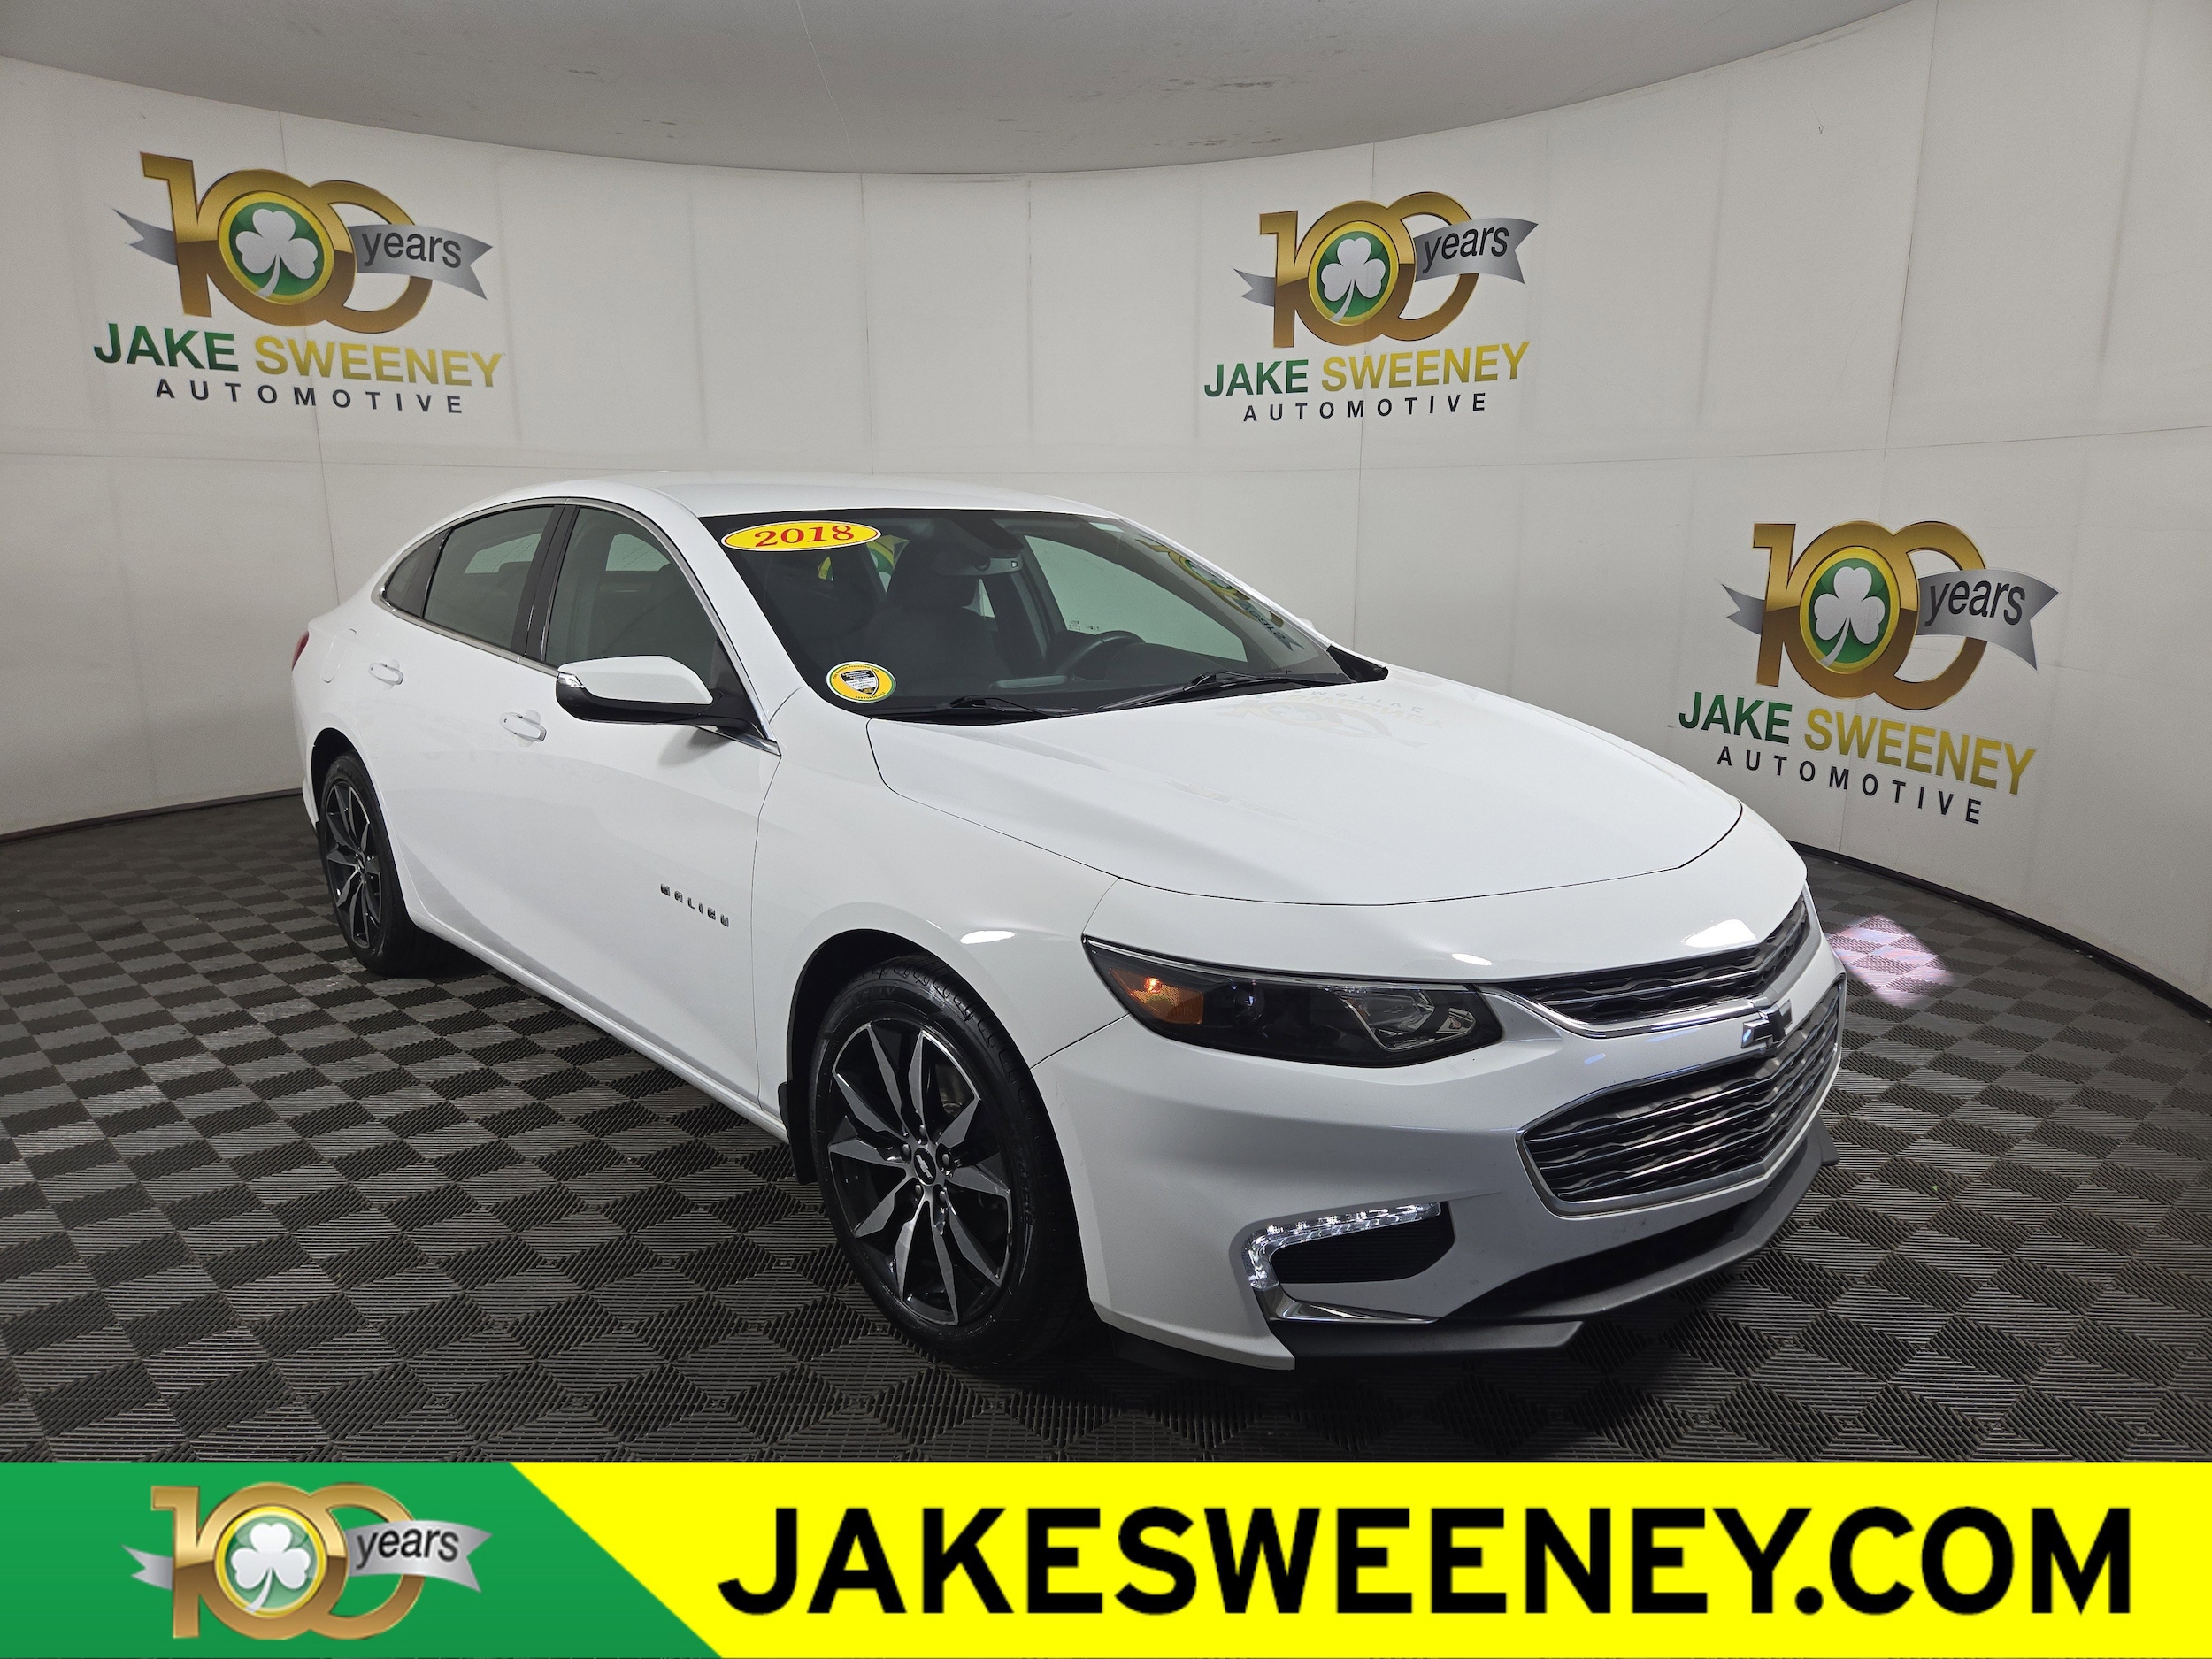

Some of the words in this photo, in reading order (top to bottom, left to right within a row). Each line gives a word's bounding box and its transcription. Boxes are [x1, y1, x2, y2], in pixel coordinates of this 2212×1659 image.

[361, 230, 462, 269] years
[1421, 226, 1509, 274] years
[93, 323, 239, 372] JAKE
[254, 335, 507, 388] SWEENEY
[1204, 358, 1310, 397] JAKE
[1321, 342, 1531, 392] SWEENEY
[156, 378, 463, 414] AUTOMOTIVE
[1243, 392, 1486, 422] AUTOMOTIVE
[754, 524, 855, 548] 2018
[1924, 580, 2026, 627] years
[1678, 691, 1793, 745] JAKE
[1803, 708, 2037, 795] SWEENEY
[1717, 746, 1983, 825] AUTOMOTIVE
[659, 883, 730, 928] MALIBU
